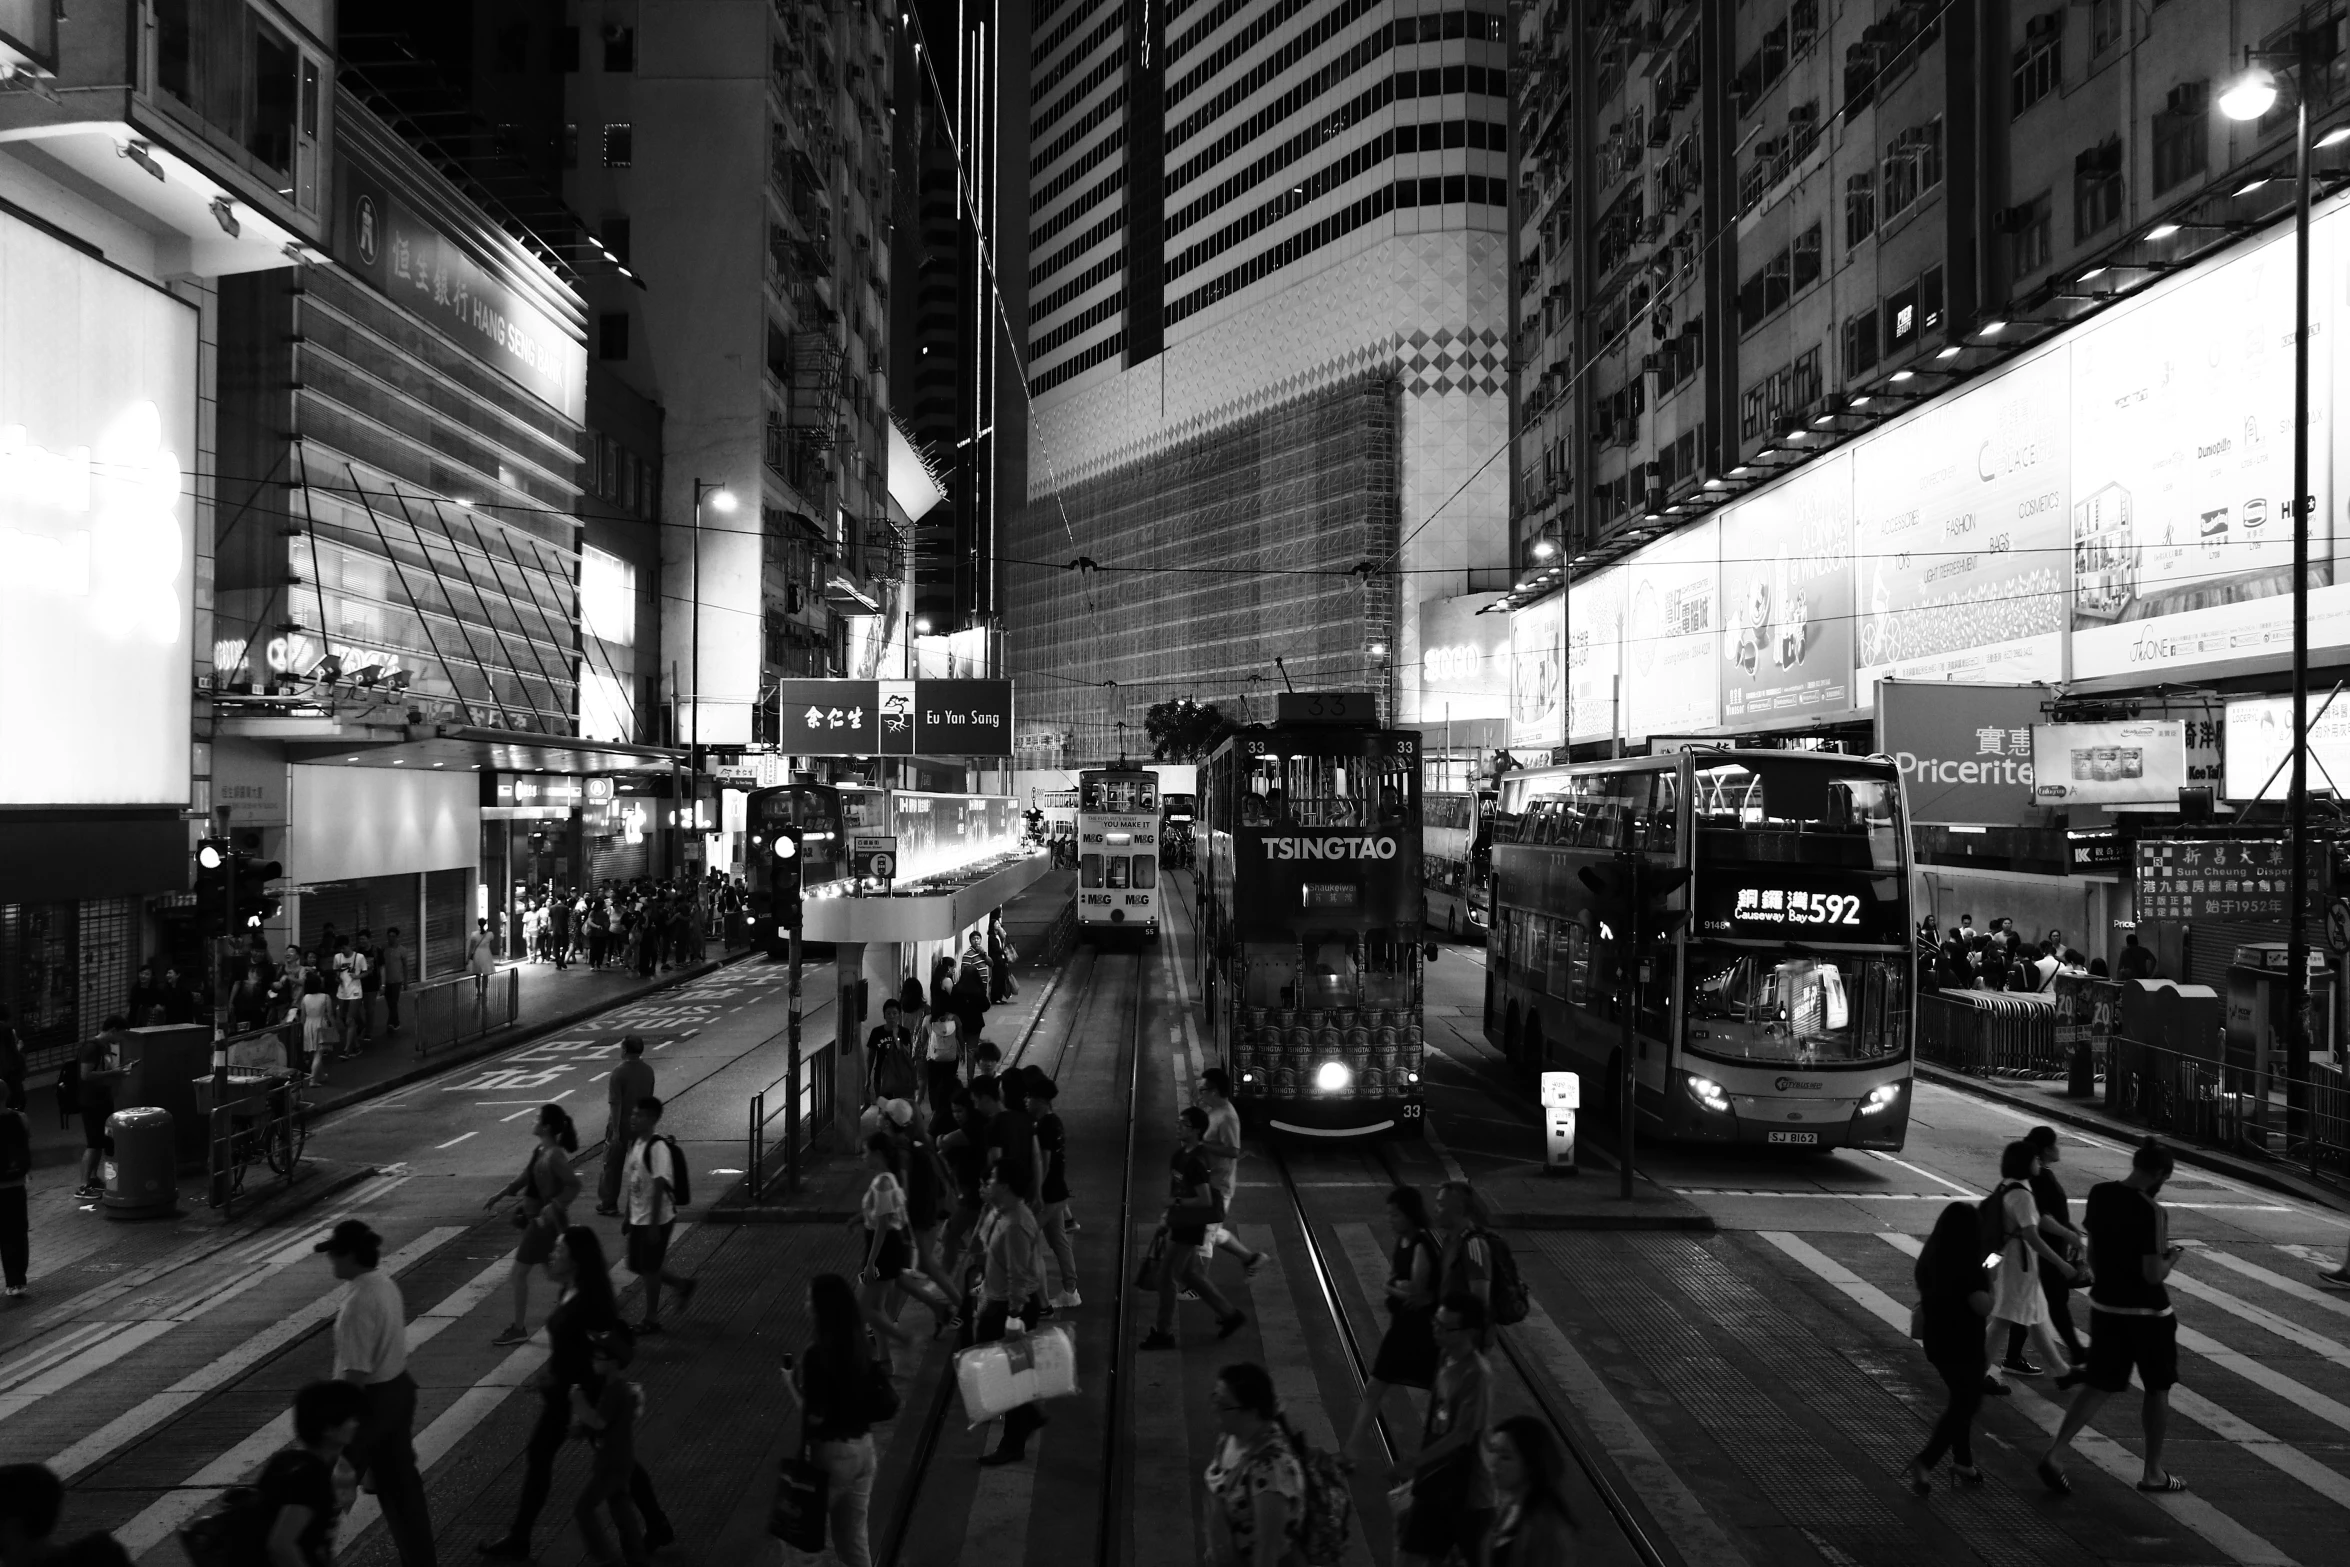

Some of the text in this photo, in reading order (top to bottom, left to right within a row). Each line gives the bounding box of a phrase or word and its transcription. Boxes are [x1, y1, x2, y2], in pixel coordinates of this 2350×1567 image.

[392, 230, 469, 322] 恒生銀行
[473, 298, 564, 389] HANG SENG BANK
[2280, 408, 2323, 434] SINAX
[2198, 437, 2232, 460] Dunlopillo
[2019, 491, 2060, 519] COSMETICS
[1946, 512, 1976, 539] FASHION
[1989, 532, 2010, 555] BAGS
[1800, 540, 1849, 582] WINDSOR
[1424, 644, 1478, 681] SOGO
[804, 705, 864, 730] 余仁生
[926, 709, 999, 728] Eu Yan Sang
[2233, 713, 2259, 724] LOCERYL
[1248, 741, 1266, 754] 33
[1396, 741, 1414, 754] 33
[1895, 751, 2033, 786] Pricerite
[2188, 765, 2205, 780] Kee
[1083, 834, 1104, 843] M&G
[1133, 834, 1155, 844] M&G
[1260, 836, 1397, 860] TSINGTAO
[1551, 854, 1567, 866] 111
[2182, 846, 2313, 867] 新昌大藥
[2176, 867, 2198, 876] Sun
[2204, 867, 2247, 880] Cheung
[1088, 894, 1112, 905] M&G
[1125, 894, 1150, 905] M&G
[1737, 889, 1808, 910] 銅鑼灣
[1809, 893, 1861, 925] 592
[2205, 900, 2282, 914] 始于1952年
[1734, 907, 1809, 924] Causeway Bay
[1145, 928, 1155, 936] 55
[1704, 921, 1726, 930] 9148
[611, 1005, 722, 1018] BUS
[572, 1016, 705, 1032] STOP
[1258, 1045, 1283, 1053] TSINGTAO
[1287, 1046, 1314, 1054] TSINGTAO
[1316, 1046, 1343, 1054] TSINGTAO
[1346, 1046, 1372, 1054] TSINGTAO
[1375, 1045, 1399, 1053] TSINGTAO
[1271, 1086, 1297, 1095] TSINGTAO
[1361, 1086, 1385, 1095] TSINGTAO
[1403, 1105, 1421, 1118] 33
[1771, 1132, 1815, 1143] SJ 8162
